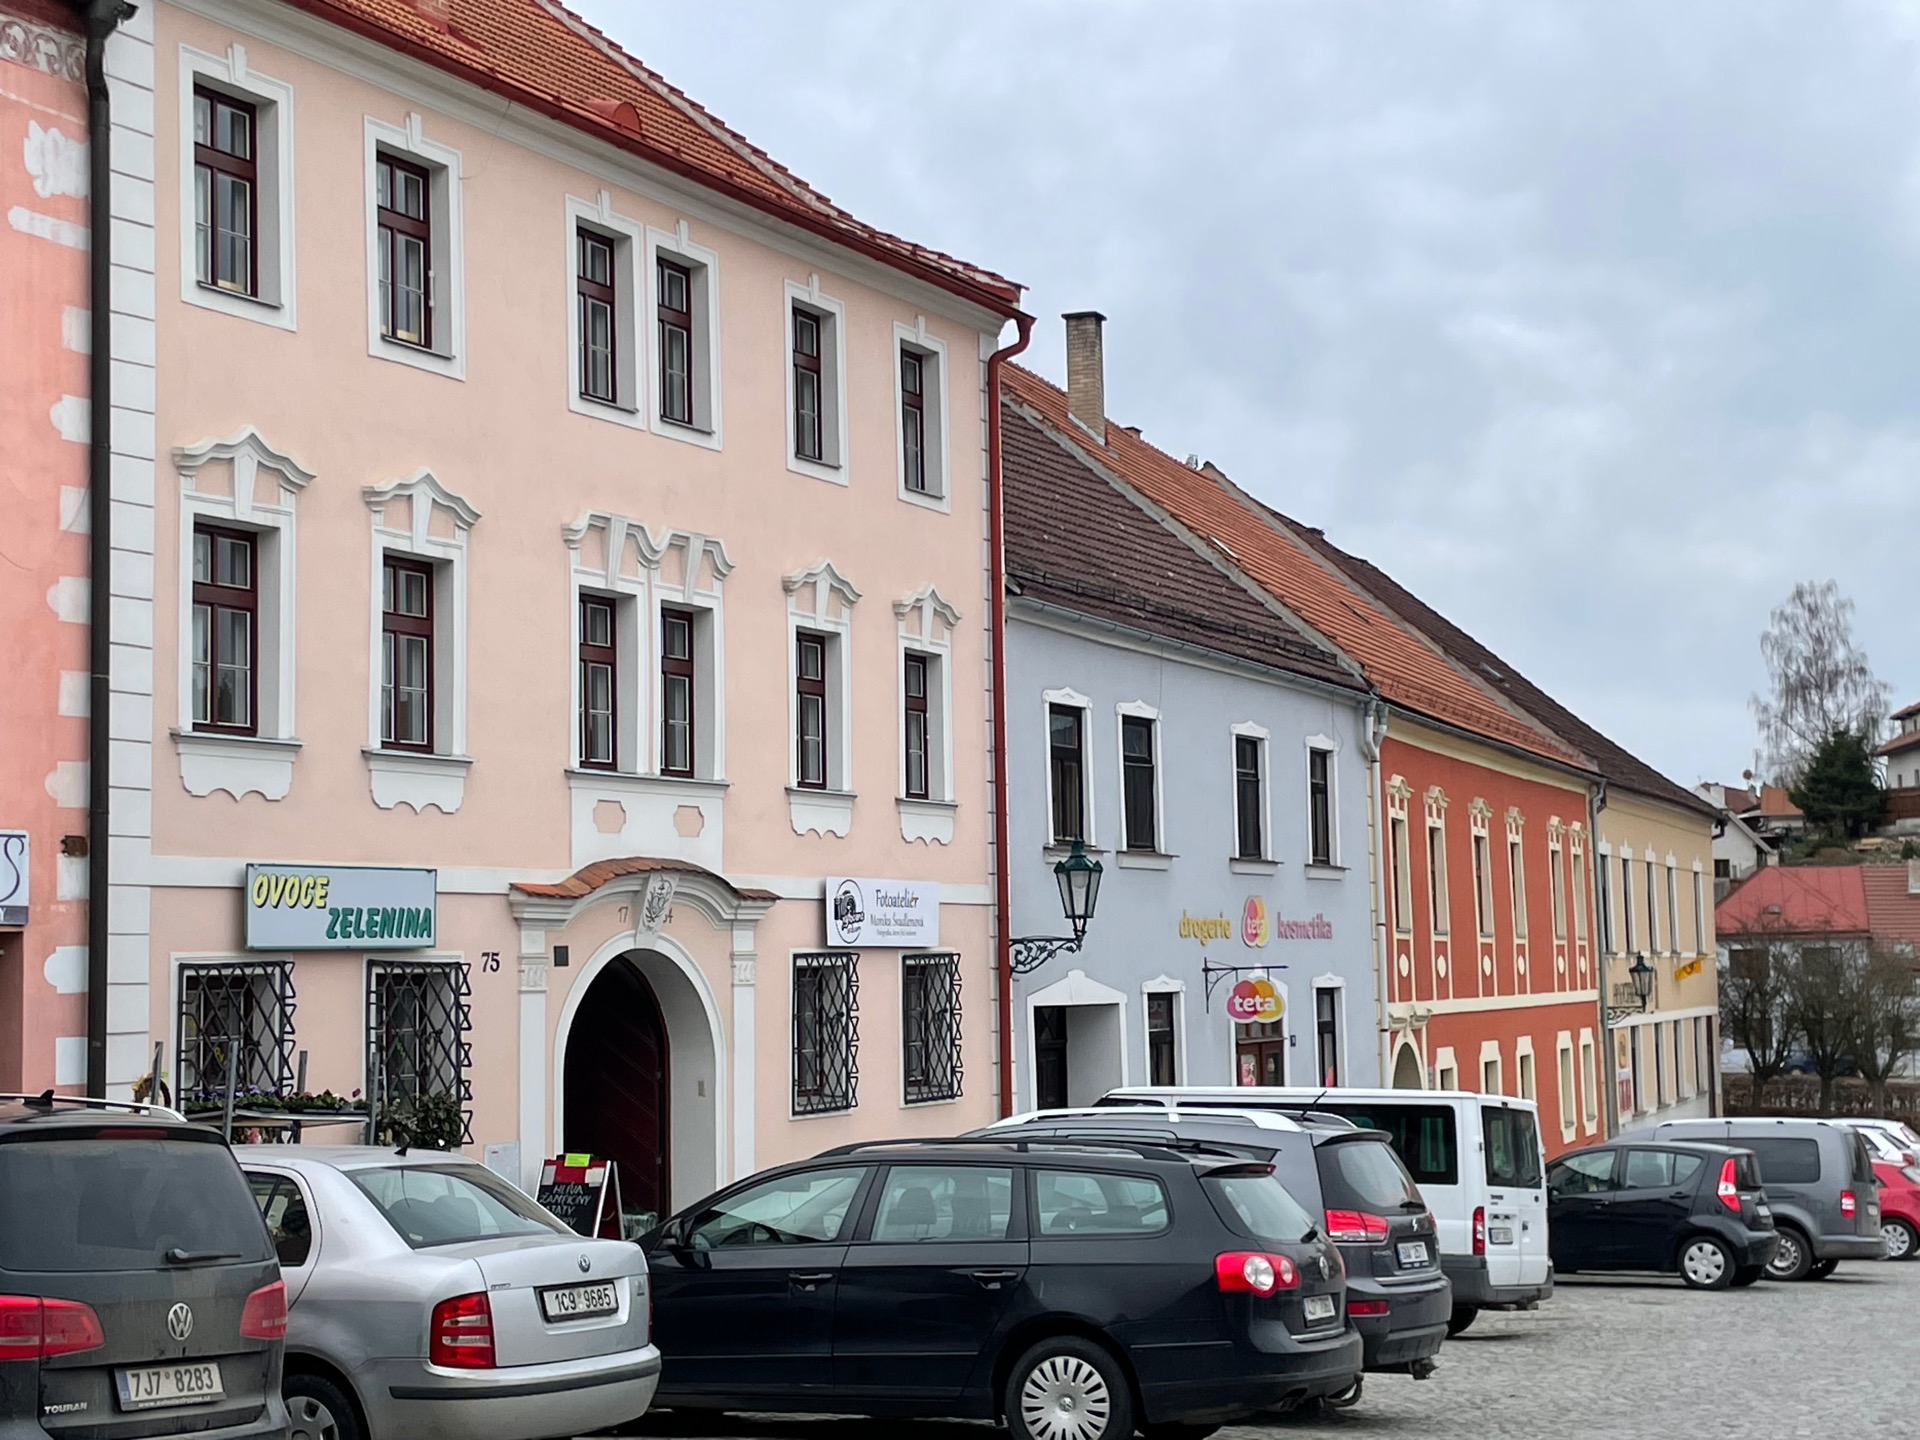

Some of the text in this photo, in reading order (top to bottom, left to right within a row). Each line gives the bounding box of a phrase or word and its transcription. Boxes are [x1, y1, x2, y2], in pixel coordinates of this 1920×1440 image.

[252, 873, 330, 909] OVOCE
[325, 907, 432, 939] ZELENINA
[1179, 909, 1232, 946] drogerie
[1277, 911, 1333, 940] kosmetika
[481, 952, 501, 972] 75
[1234, 995, 1276, 1012] teta
[555, 1287, 612, 1312] 1C9 9685
[131, 1366, 214, 1398] 7J7 8283
[44, 1402, 88, 1414] TOURAN
